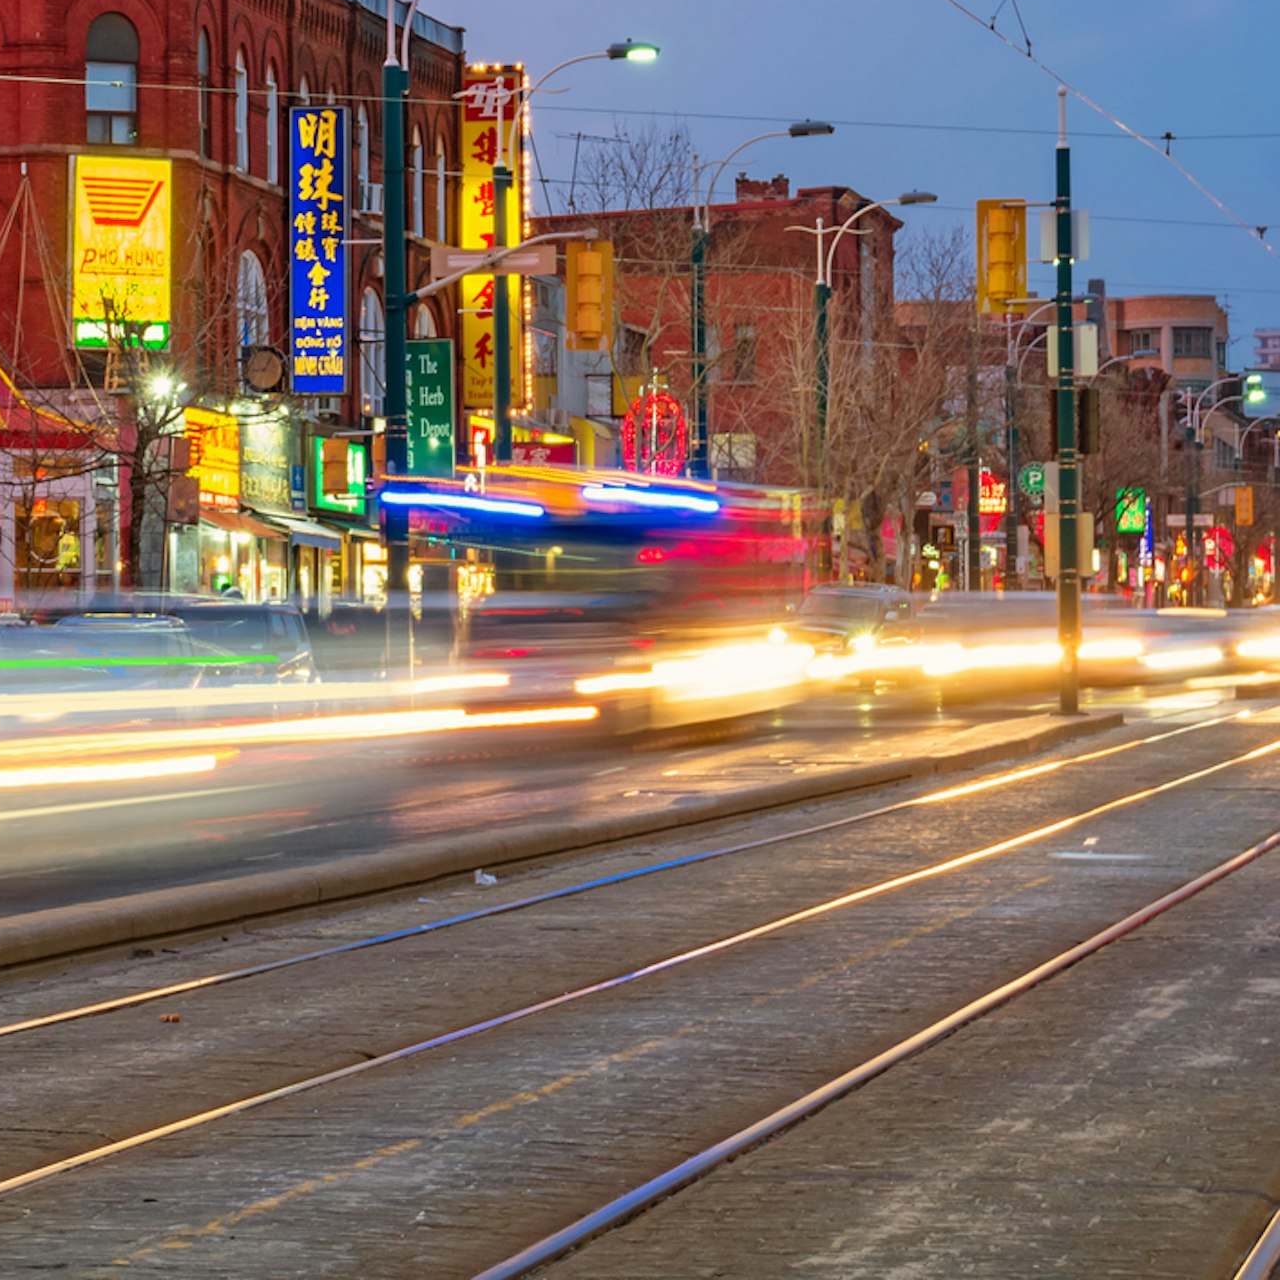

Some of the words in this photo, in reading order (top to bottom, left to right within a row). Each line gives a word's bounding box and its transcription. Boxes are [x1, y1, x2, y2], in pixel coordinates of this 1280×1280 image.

[297, 109, 344, 212] 明珠
[419, 353, 438, 375] The
[419, 384, 445, 407] Herb
[420, 417, 450, 438] Depot
